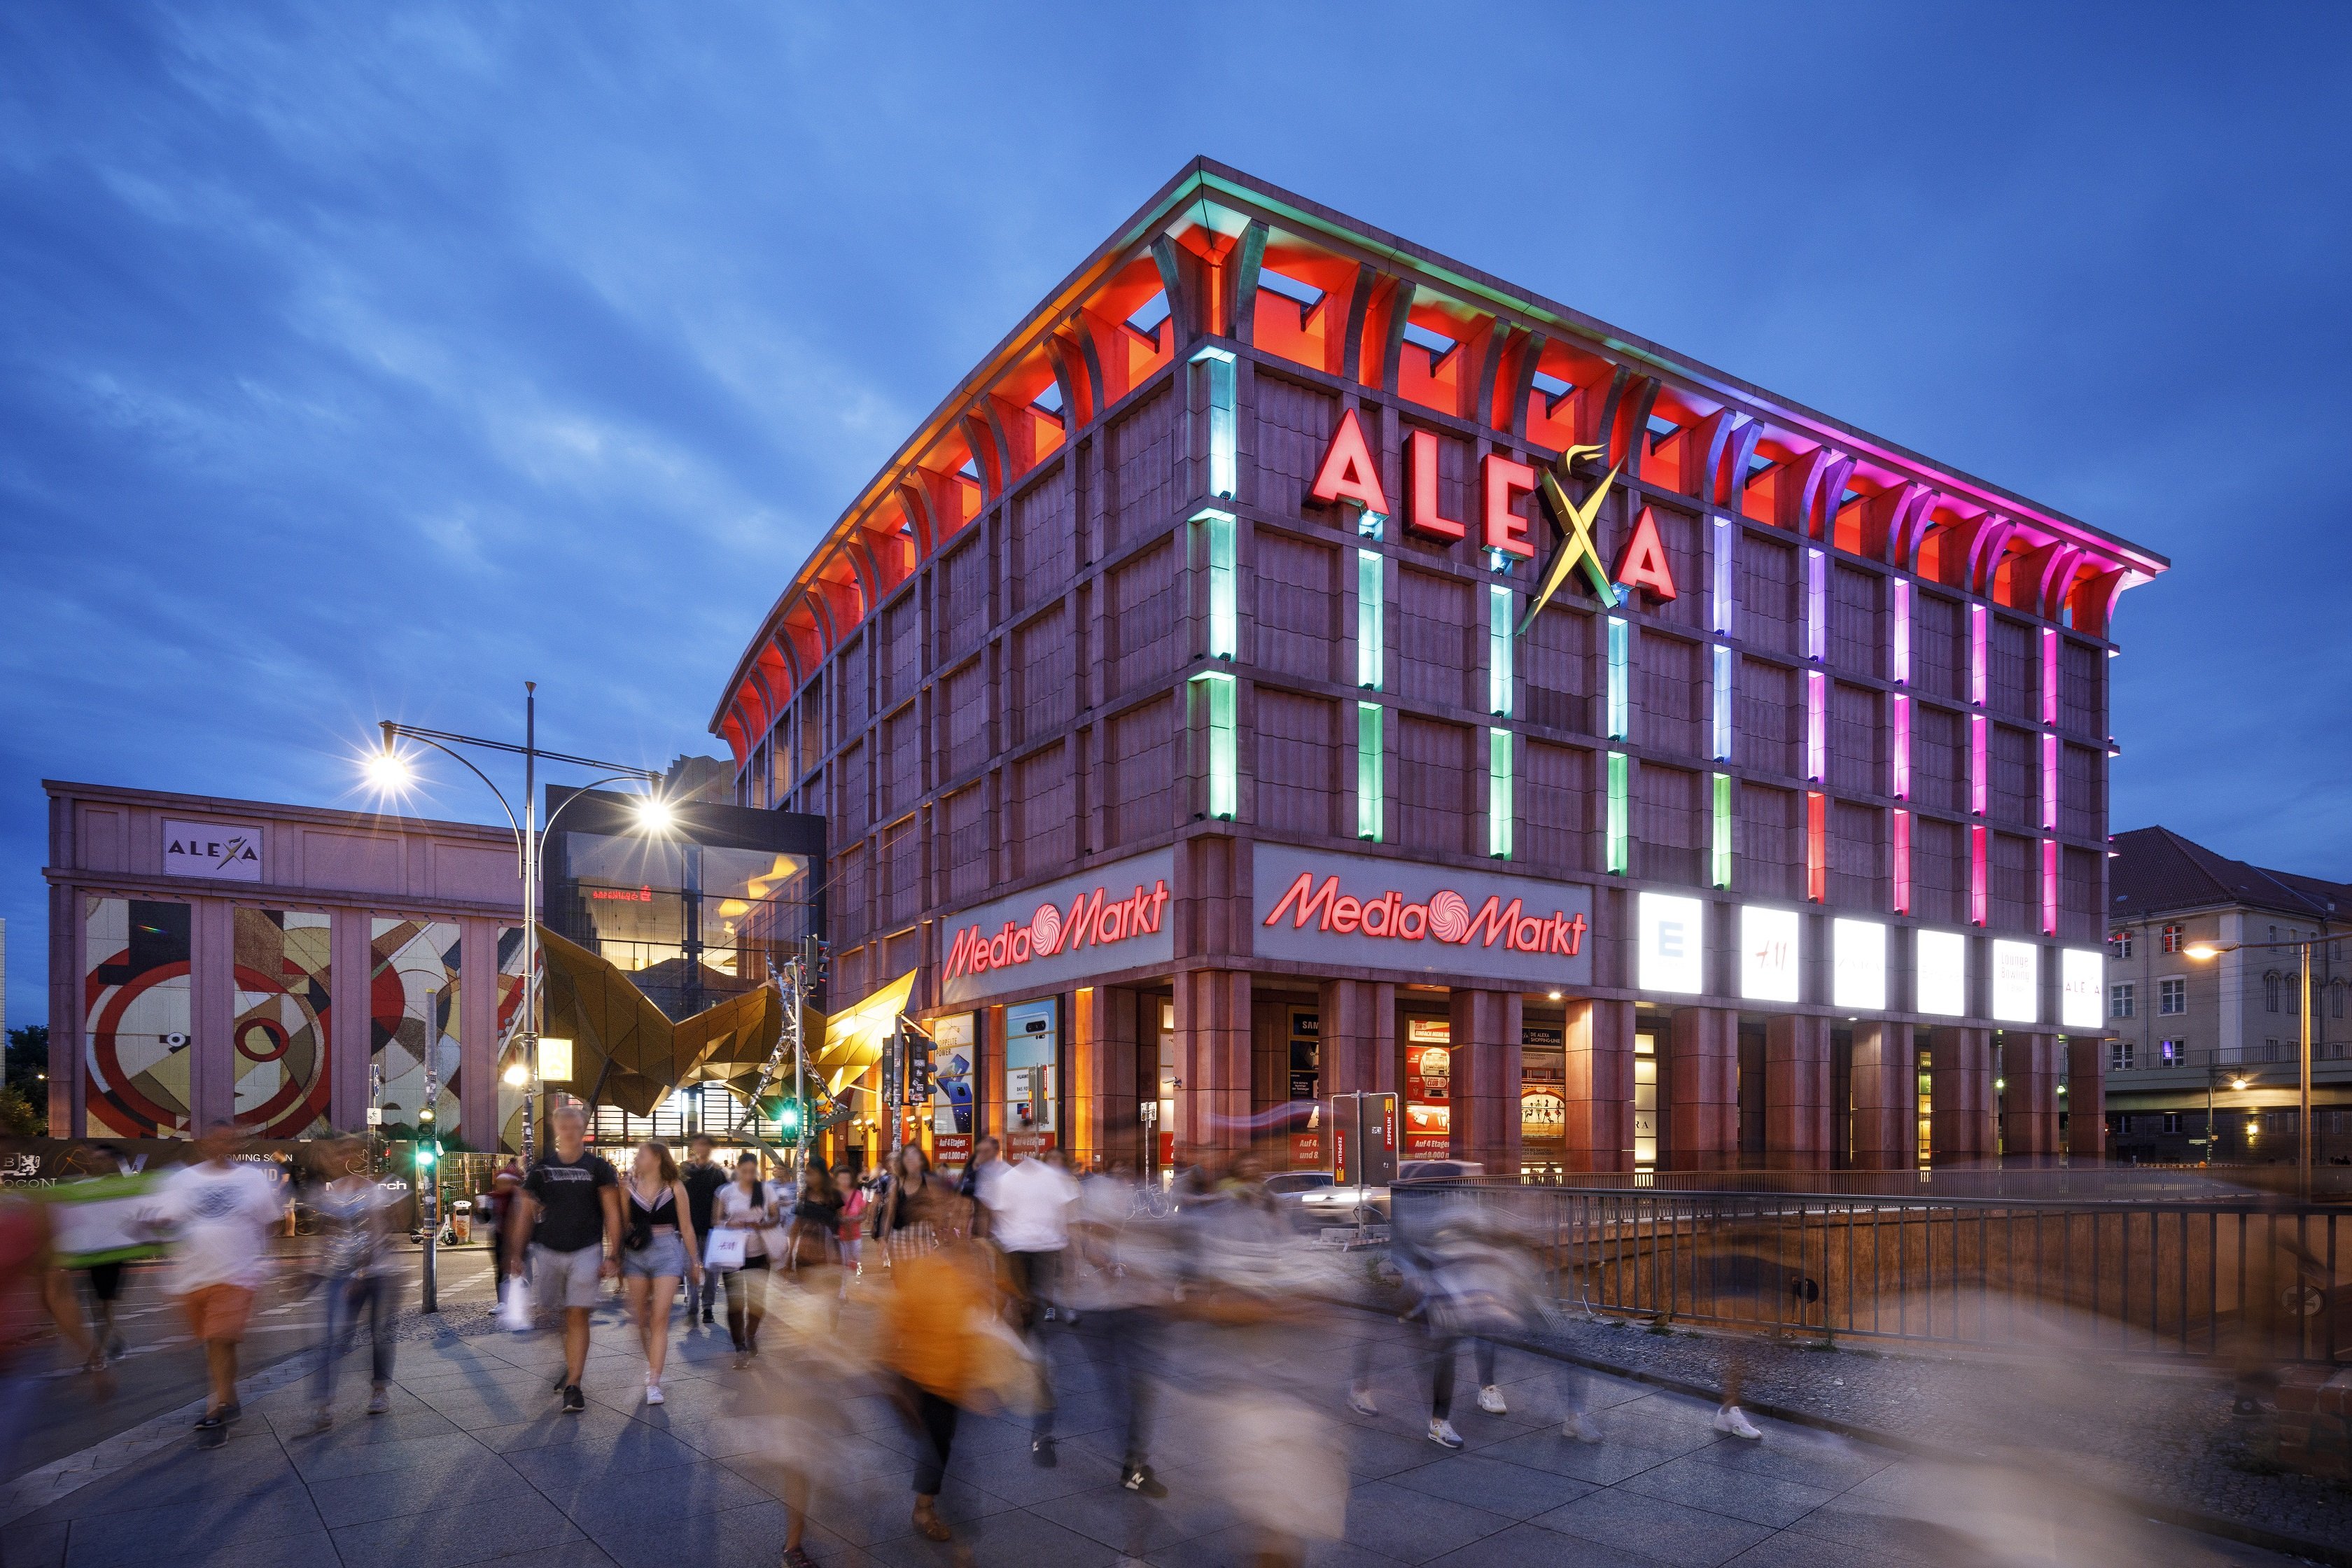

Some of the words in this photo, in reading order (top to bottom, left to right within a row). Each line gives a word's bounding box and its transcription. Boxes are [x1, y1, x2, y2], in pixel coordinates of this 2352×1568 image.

[1304, 407, 1676, 636] ALEXA
[168, 836, 258, 870] ALEXA
[2002, 952, 2029, 967] Lounge
[2001, 967, 2029, 983] Bowling
[1415, 1140, 1427, 1148] Auf
[1415, 1150, 1427, 1158] und
